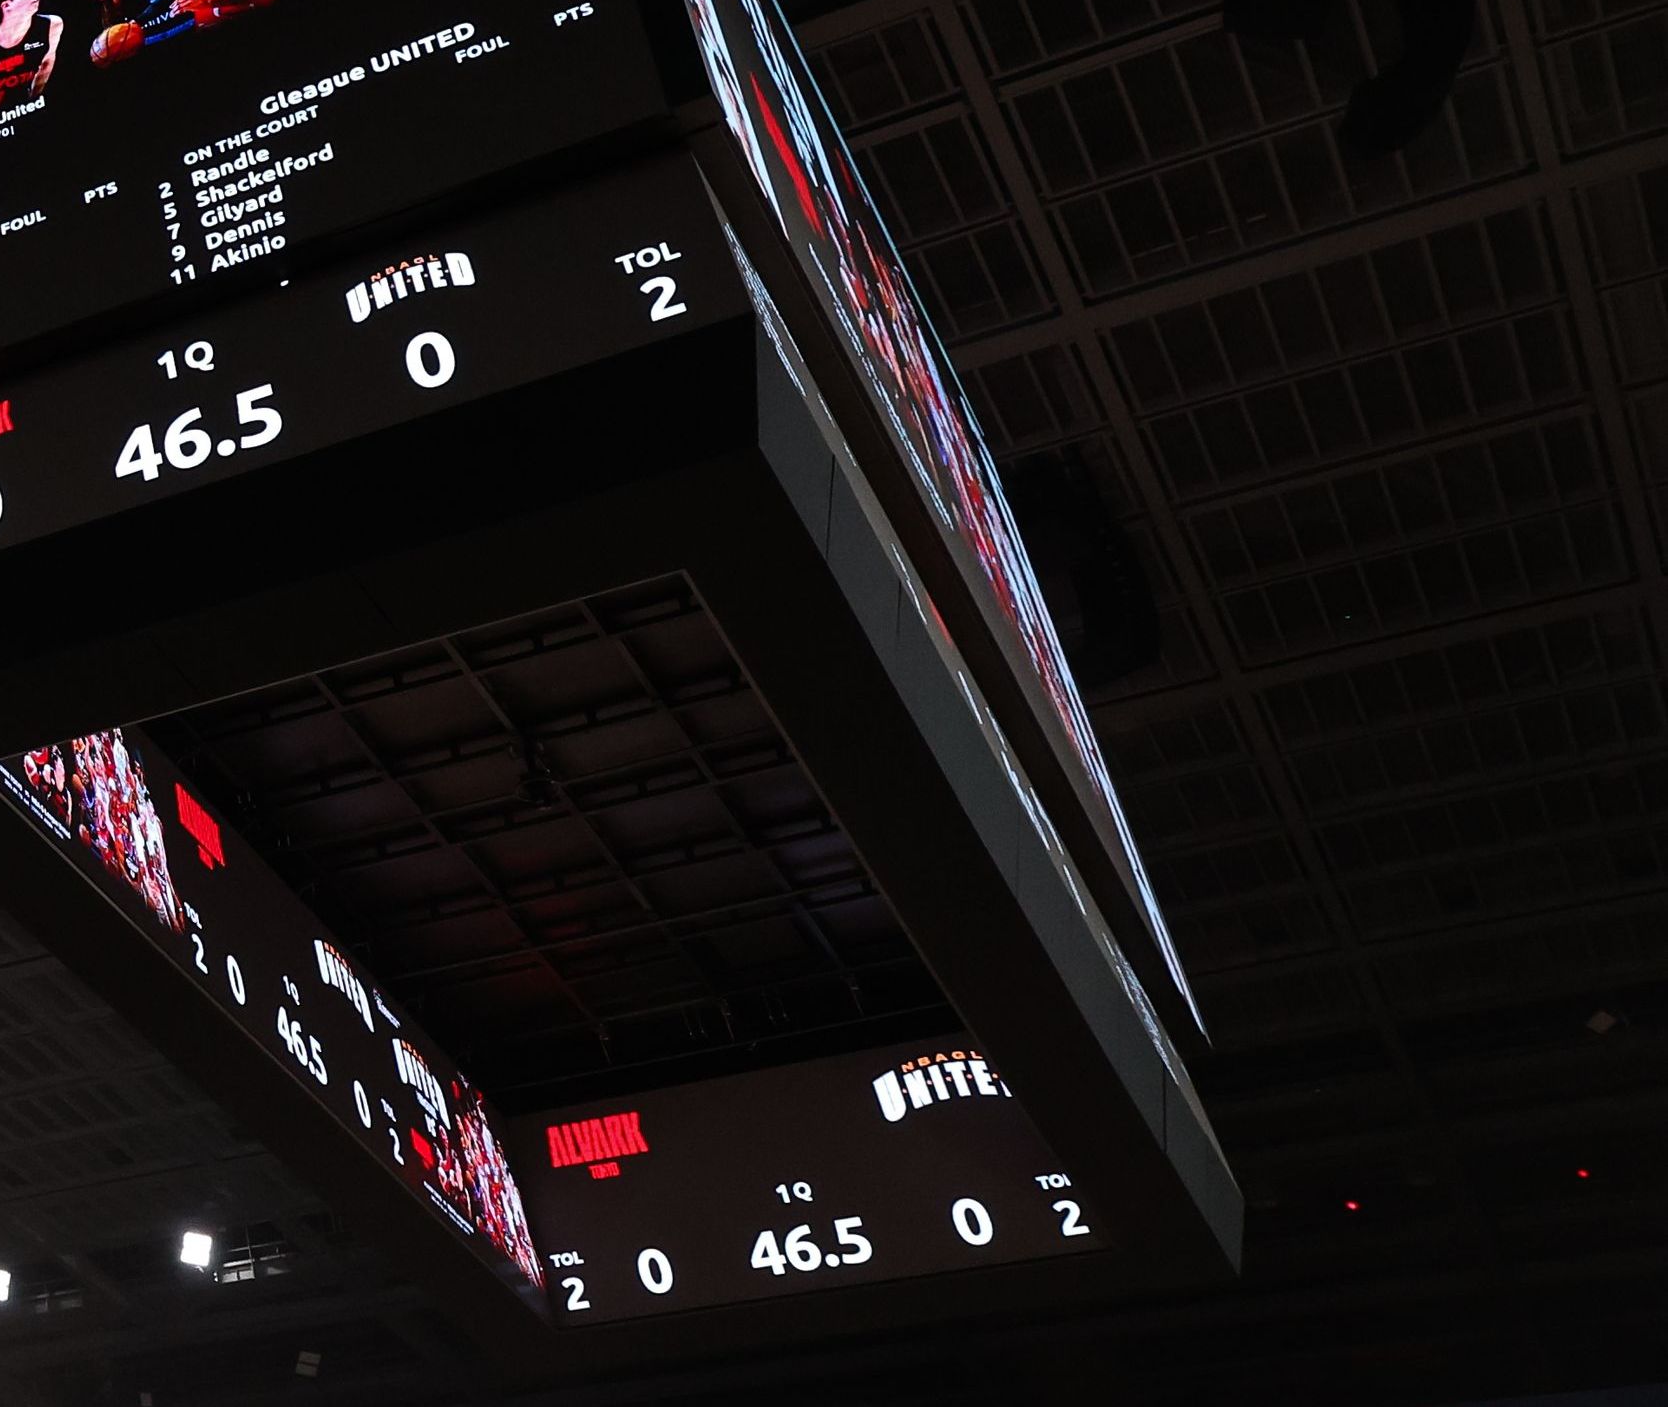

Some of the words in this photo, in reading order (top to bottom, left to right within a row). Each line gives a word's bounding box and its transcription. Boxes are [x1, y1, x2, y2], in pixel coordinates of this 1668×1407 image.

[454, 35, 510, 64] FOUL
[554, 2, 594, 27] PTS
[260, 65, 365, 114] Gleague
[370, 22, 475, 74] UNITED
[183, 145, 213, 165] ON
[215, 130, 253, 153] THE
[256, 105, 319, 138] COURT
[158, 182, 173, 199] 2
[191, 148, 270, 187] Randle
[163, 202, 177, 220] 5
[195, 142, 334, 208] Shackelford
[0, 210, 46, 235] FOUL
[84, 182, 118, 204] PTS
[166, 223, 181, 240] 7
[200, 184, 283, 228] Gilyard
[170, 264, 196, 285] 11
[211, 235, 286, 272] Akinio
[171, 244, 186, 262] 9
[205, 211, 286, 250] Dennis
[615, 242, 681, 276] TOL
[346, 253, 476, 323] UNITED
[640, 275, 687, 323] 2
[158, 339, 214, 381] 1Q
[405, 331, 456, 388] 0
[115, 384, 284, 484] 46.5
[277, 1006, 328, 1085] 46.5
[872, 1060, 1013, 1123] UNITE
[546, 1111, 649, 1168] ALVARK
[775, 1181, 813, 1204] 1Q
[1052, 1199, 1091, 1237] 2
[750, 1216, 873, 1277] 46.5
[951, 1198, 993, 1246] 0
[549, 1251, 584, 1268] TOL
[637, 1248, 674, 1295] 0
[561, 1276, 591, 1311] 2
